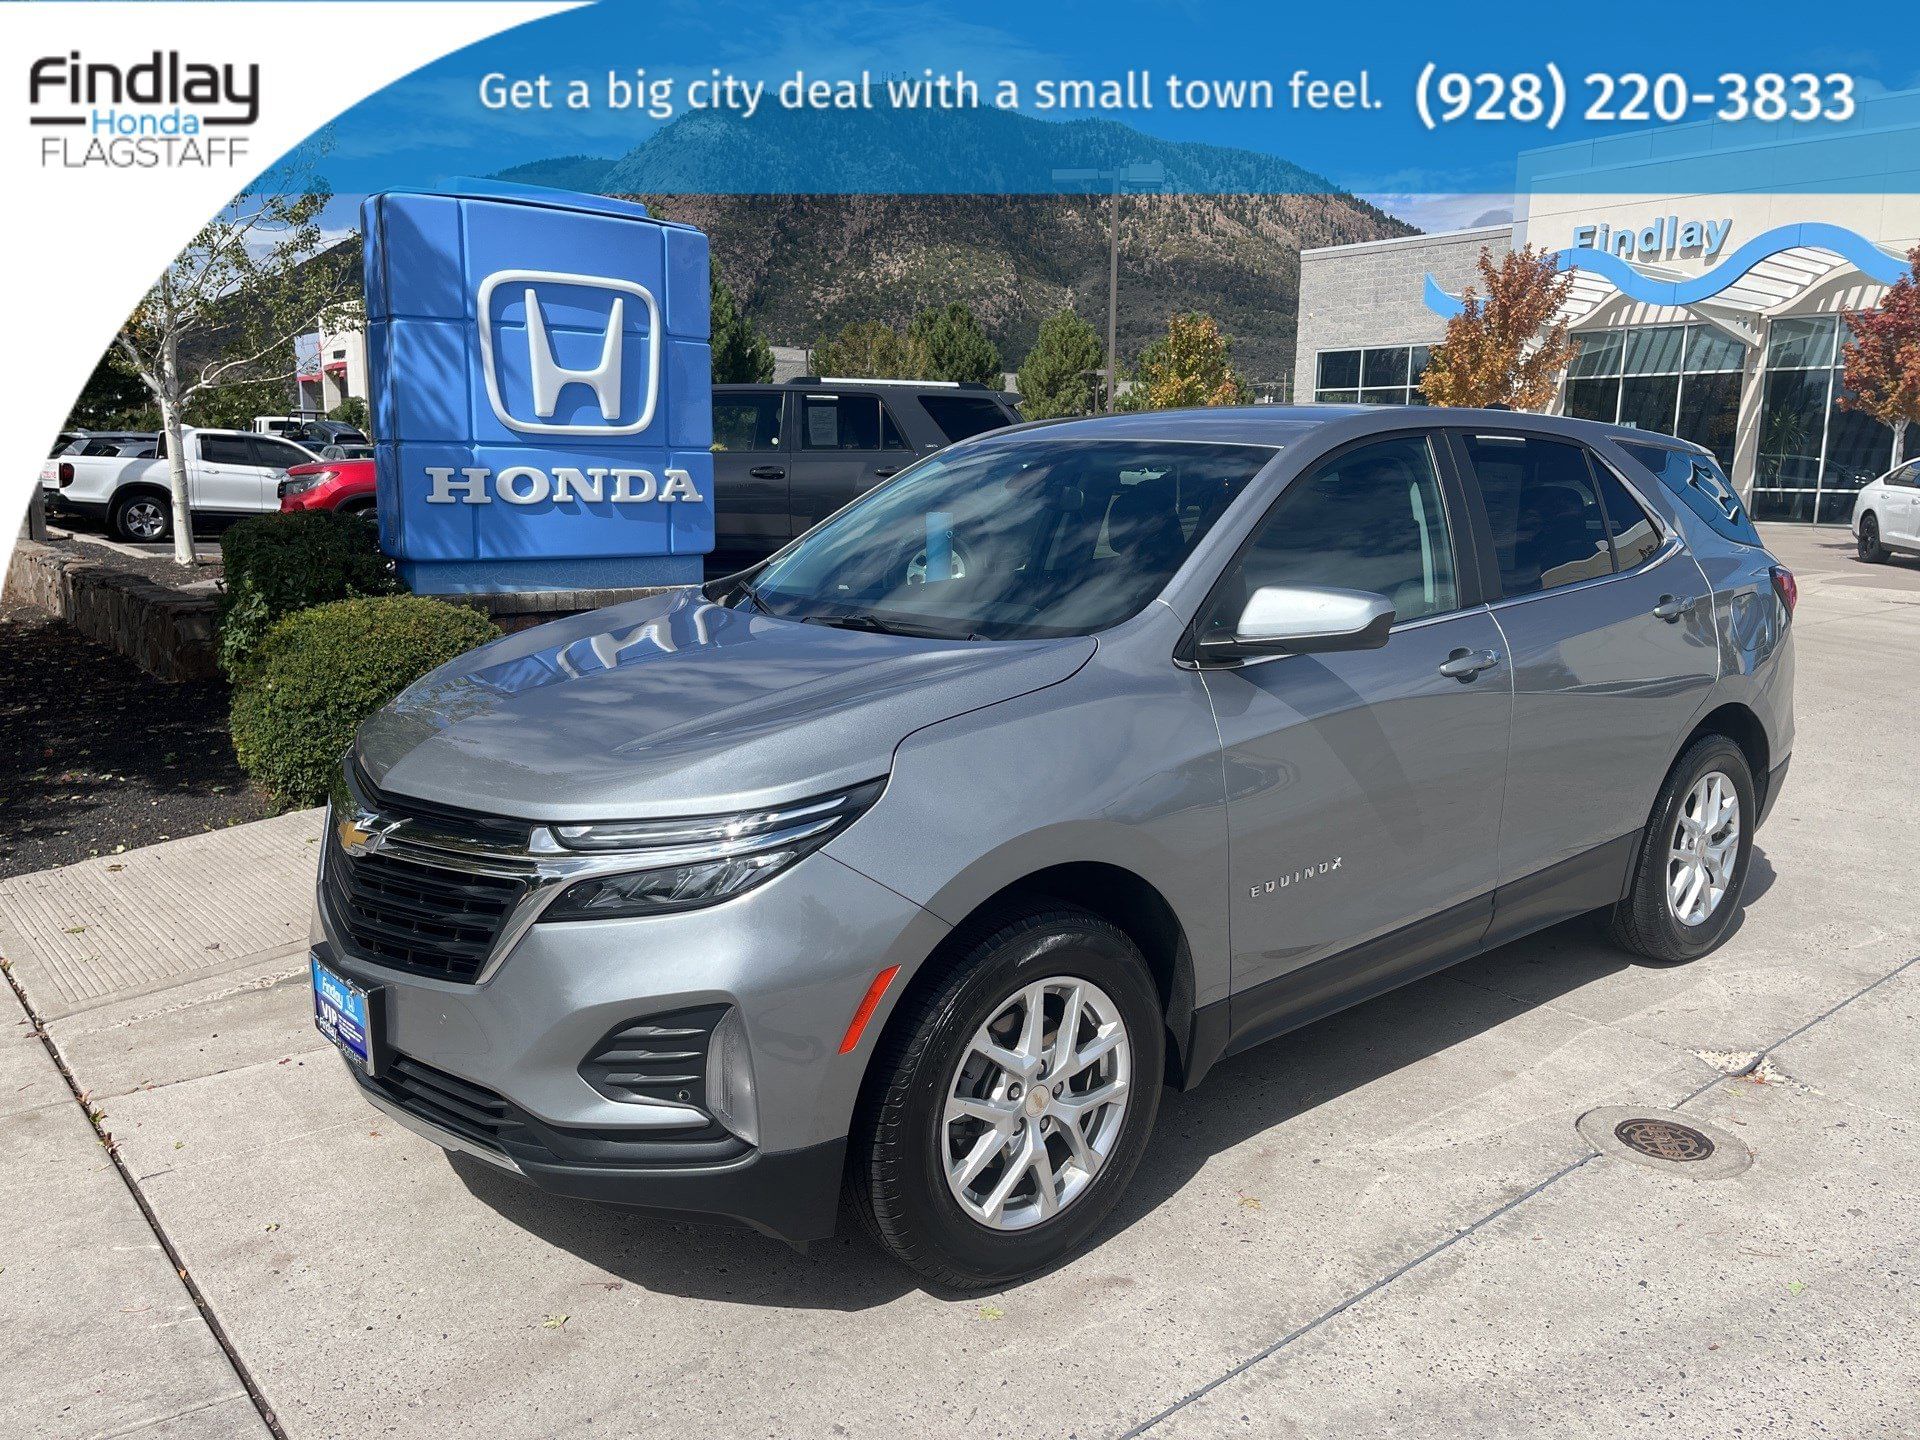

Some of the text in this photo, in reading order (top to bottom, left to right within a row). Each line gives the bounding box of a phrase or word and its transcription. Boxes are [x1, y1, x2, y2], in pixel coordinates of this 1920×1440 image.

[1572, 215, 1733, 256] Findlay
[425, 466, 704, 504] HONDA
[1249, 856, 1343, 898] EQUINOX
